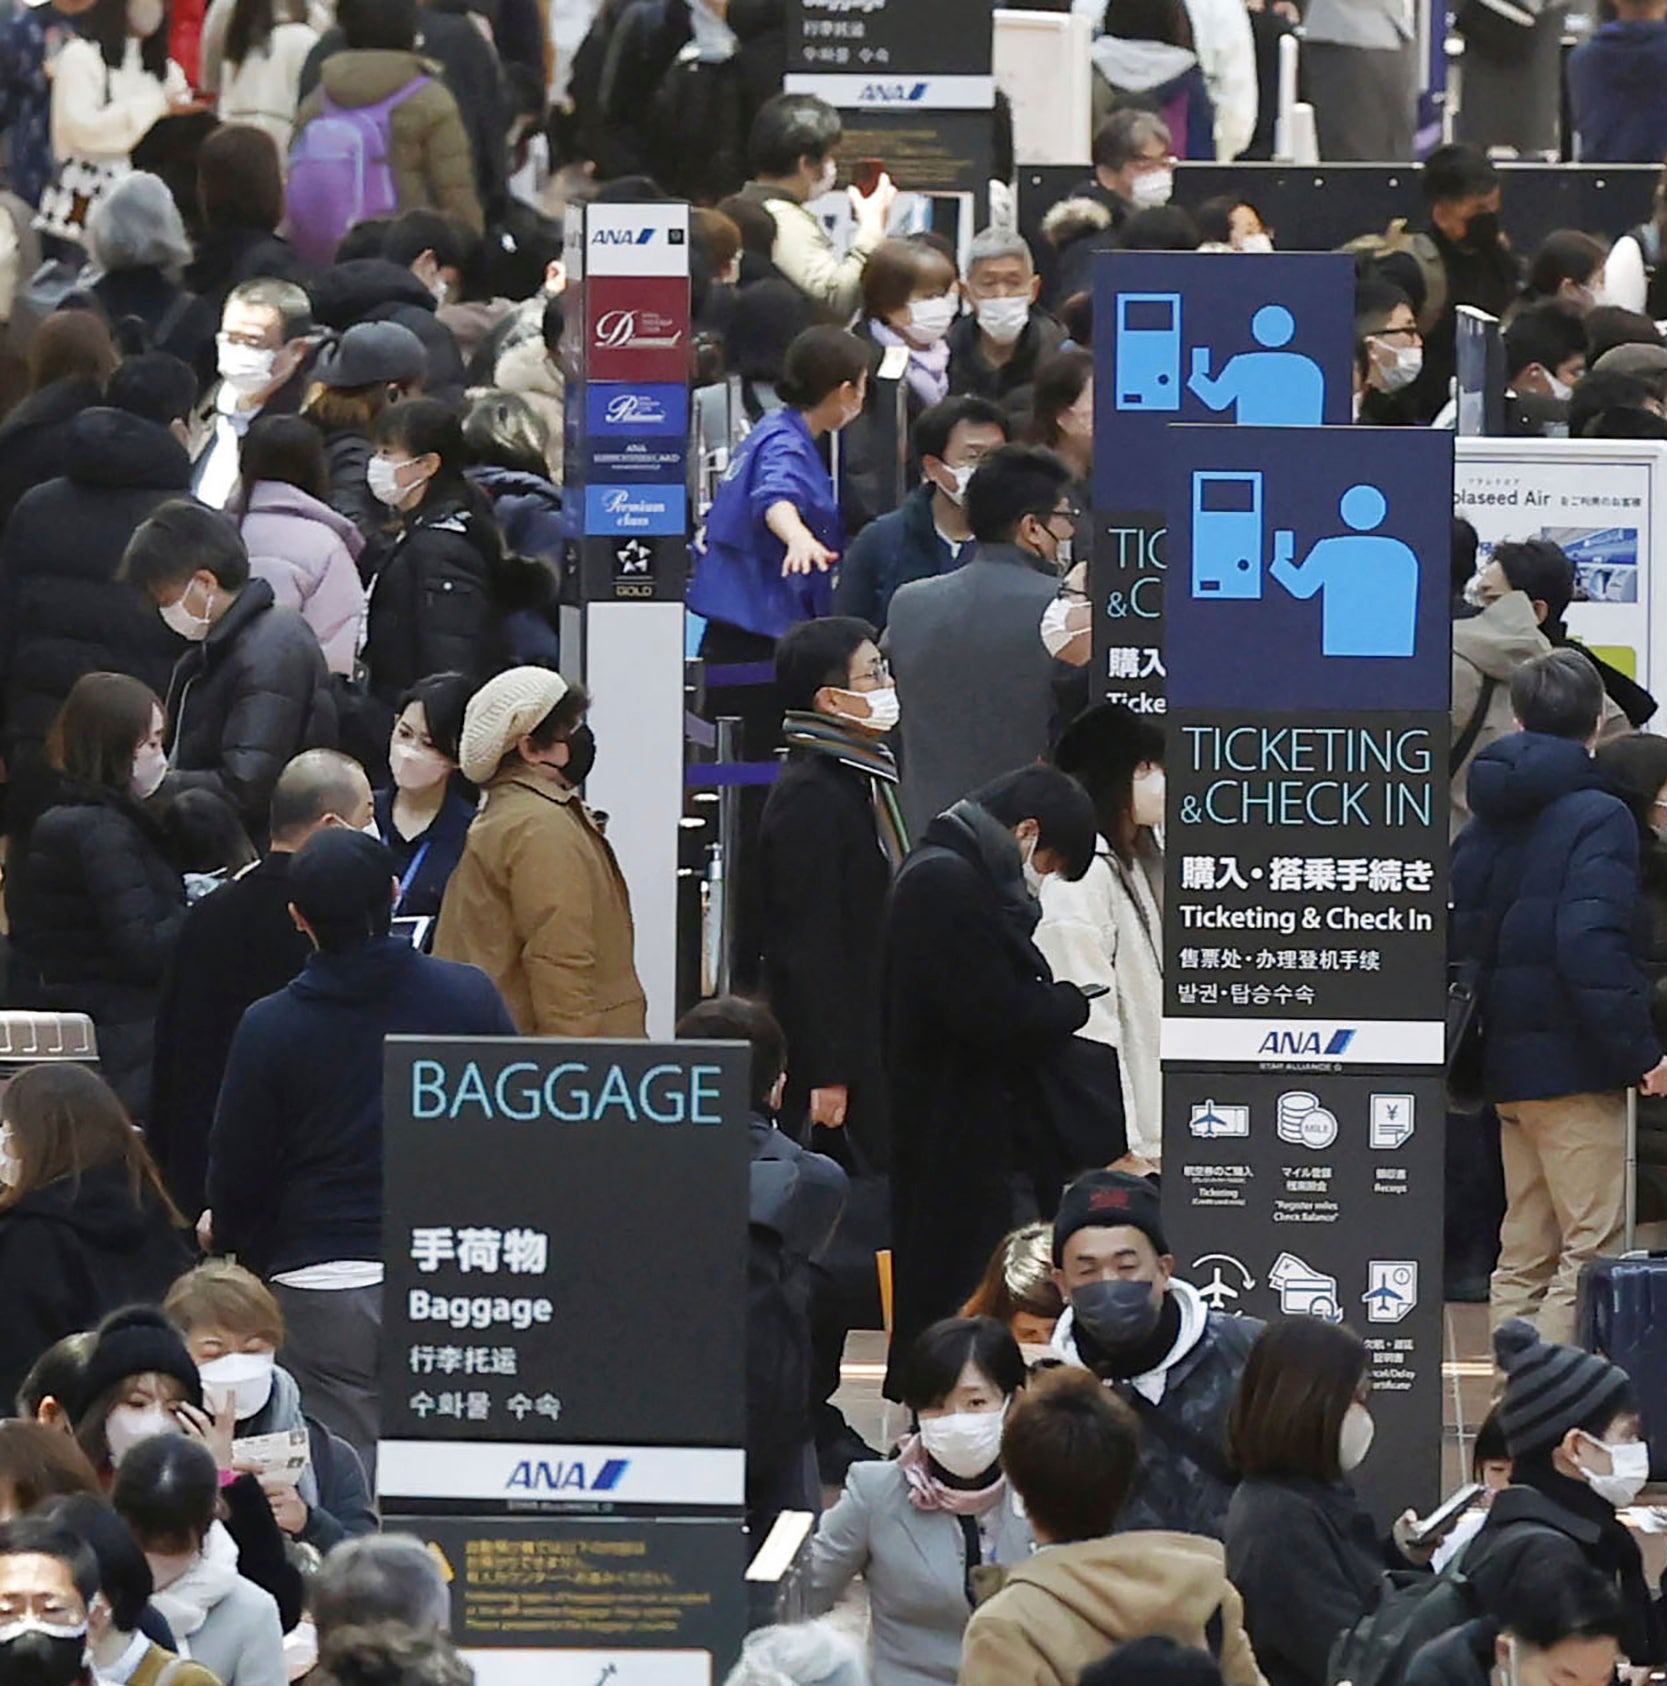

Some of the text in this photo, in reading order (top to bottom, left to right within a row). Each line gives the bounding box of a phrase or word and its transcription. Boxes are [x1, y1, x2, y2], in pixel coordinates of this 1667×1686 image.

[857, 83, 905, 101] ANA
[591, 229, 633, 245] ANA
[1453, 489, 1550, 506] olaseed Air
[1181, 726, 1432, 774] TICKETING
[1386, 782, 1431, 827] IN
[1181, 855, 1434, 893] 購入・搭乗手続き
[1179, 904, 1433, 934] Ticketing & Check In
[1257, 1031, 1322, 1055] ANA
[411, 1060, 723, 1124] BAGGAGE
[1199, 1187, 1239, 1199] Ticketing
[1273, 1212, 1300, 1223] Check
[410, 1227, 549, 1274] 手荷物
[408, 1289, 554, 1328] Baggage
[409, 1345, 518, 1376] 行李托运
[409, 1391, 562, 1421] 수화물 수속
[506, 1460, 585, 1490] ANA
